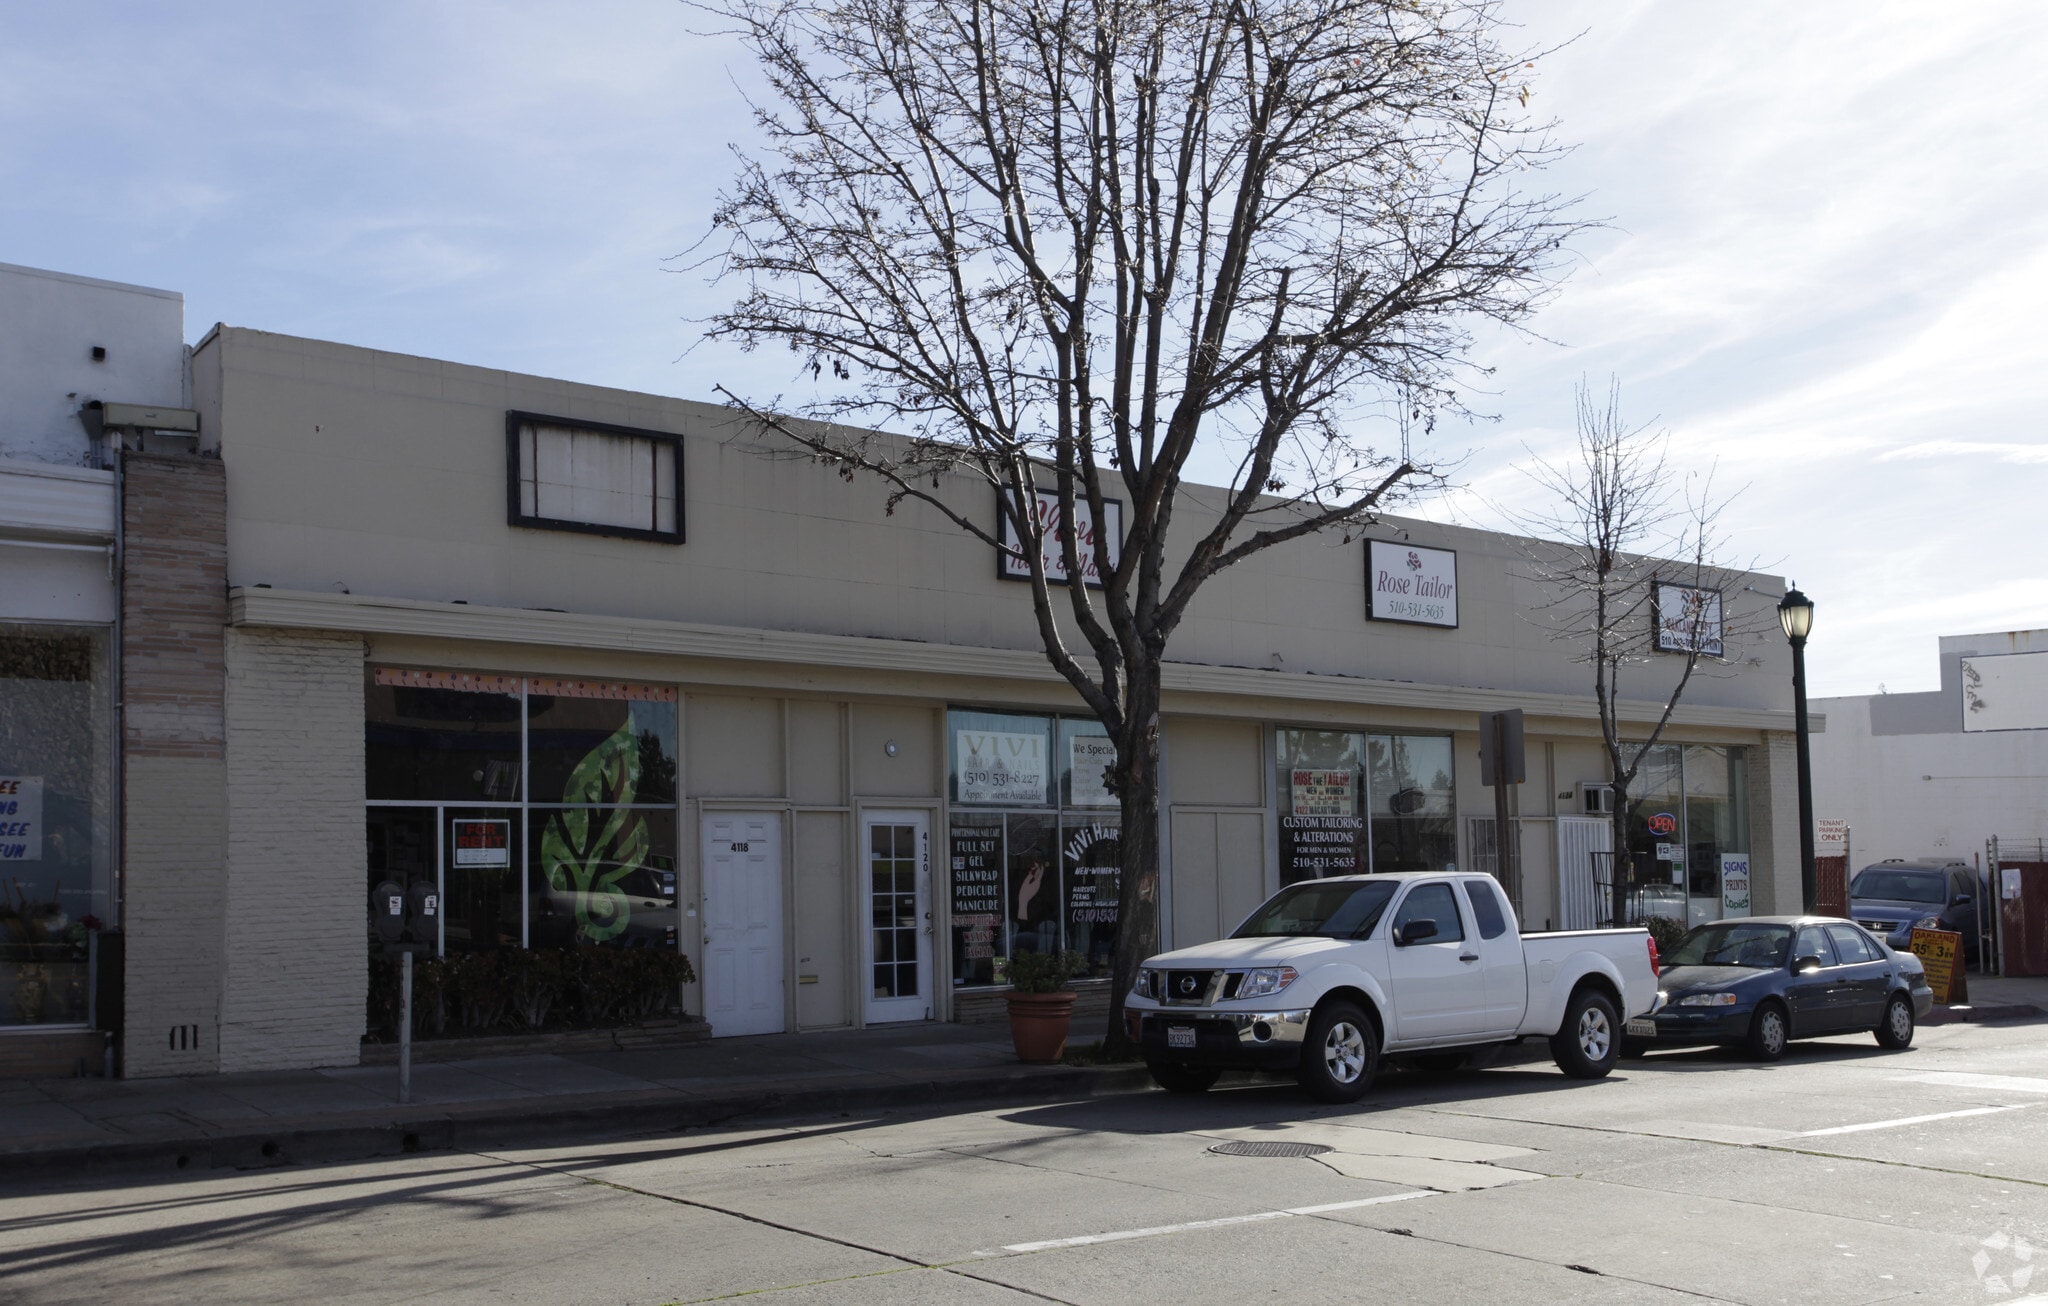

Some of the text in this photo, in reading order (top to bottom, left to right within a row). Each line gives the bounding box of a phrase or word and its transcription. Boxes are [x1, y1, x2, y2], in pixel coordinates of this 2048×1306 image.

[1377, 570, 1453, 600] Rose Tailor
[1388, 600, 1444, 620] 510-531-5635
[963, 735, 1039, 758] VIVI
[1073, 743, 1086, 754] We
[964, 770, 1040, 787] (510) 531-8227
[1293, 771, 1350, 787] ROSE THE TAILOR
[1010, 790, 1042, 801] Available
[1325, 786, 1345, 795] WOMEN
[1283, 816, 1363, 829] CUSTOM TAILORING
[1648, 815, 1677, 833] OPEN
[466, 823, 496, 835] FOR
[1092, 821, 1119, 842] HAIR
[1818, 826, 1846, 834] PARKING
[458, 836, 504, 848] RENT
[1293, 831, 1354, 843] & ALTERATIONS
[1821, 833, 1842, 841] ONLY
[731, 842, 749, 852] 4118
[957, 841, 996, 852] FULL SET
[1296, 846, 1352, 854] FOR MEN & WOMEN
[969, 855, 984, 867] GEL
[1292, 857, 1356, 868] 510-531-5635
[1724, 861, 1747, 876] SIGNS
[955, 870, 998, 881] SILKWRAP
[956, 885, 998, 896] PEDICURE
[1725, 879, 1748, 891] PRINTS
[1072, 893, 1090, 901] PERMS
[1725, 892, 1749, 910] Copies
[955, 899, 998, 911] MANICURE
[1914, 931, 1956, 944] OAKLAND
